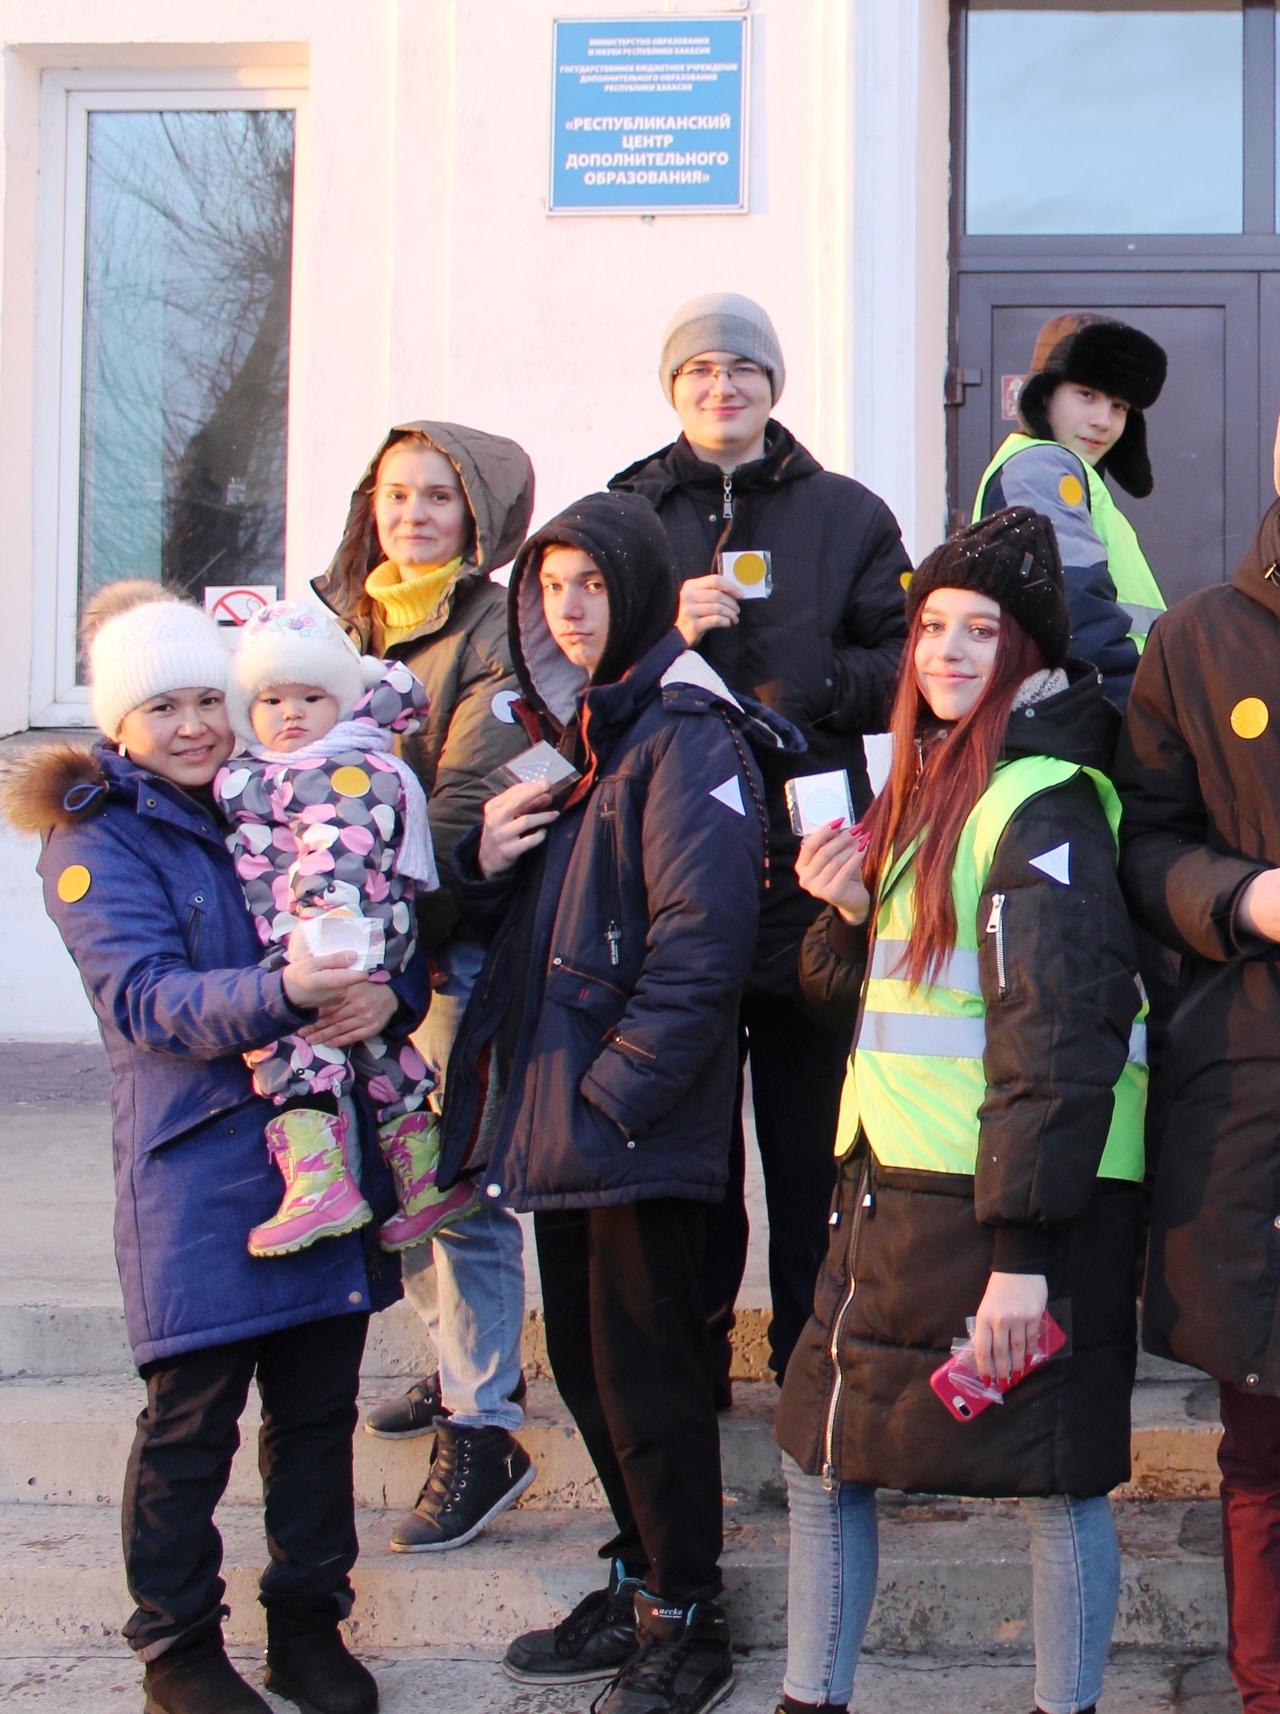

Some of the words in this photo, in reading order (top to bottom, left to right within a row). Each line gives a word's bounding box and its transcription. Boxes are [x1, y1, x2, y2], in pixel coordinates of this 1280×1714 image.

[565, 113, 731, 131] «РЕСПУБЛИКАНСКИЙ
[621, 134, 674, 151] ЦЕНТР
[565, 151, 729, 170] ДОПОЛНИТЕЛЬНОГО
[583, 170, 710, 185] ОБРАЗОВАНИЯ»
